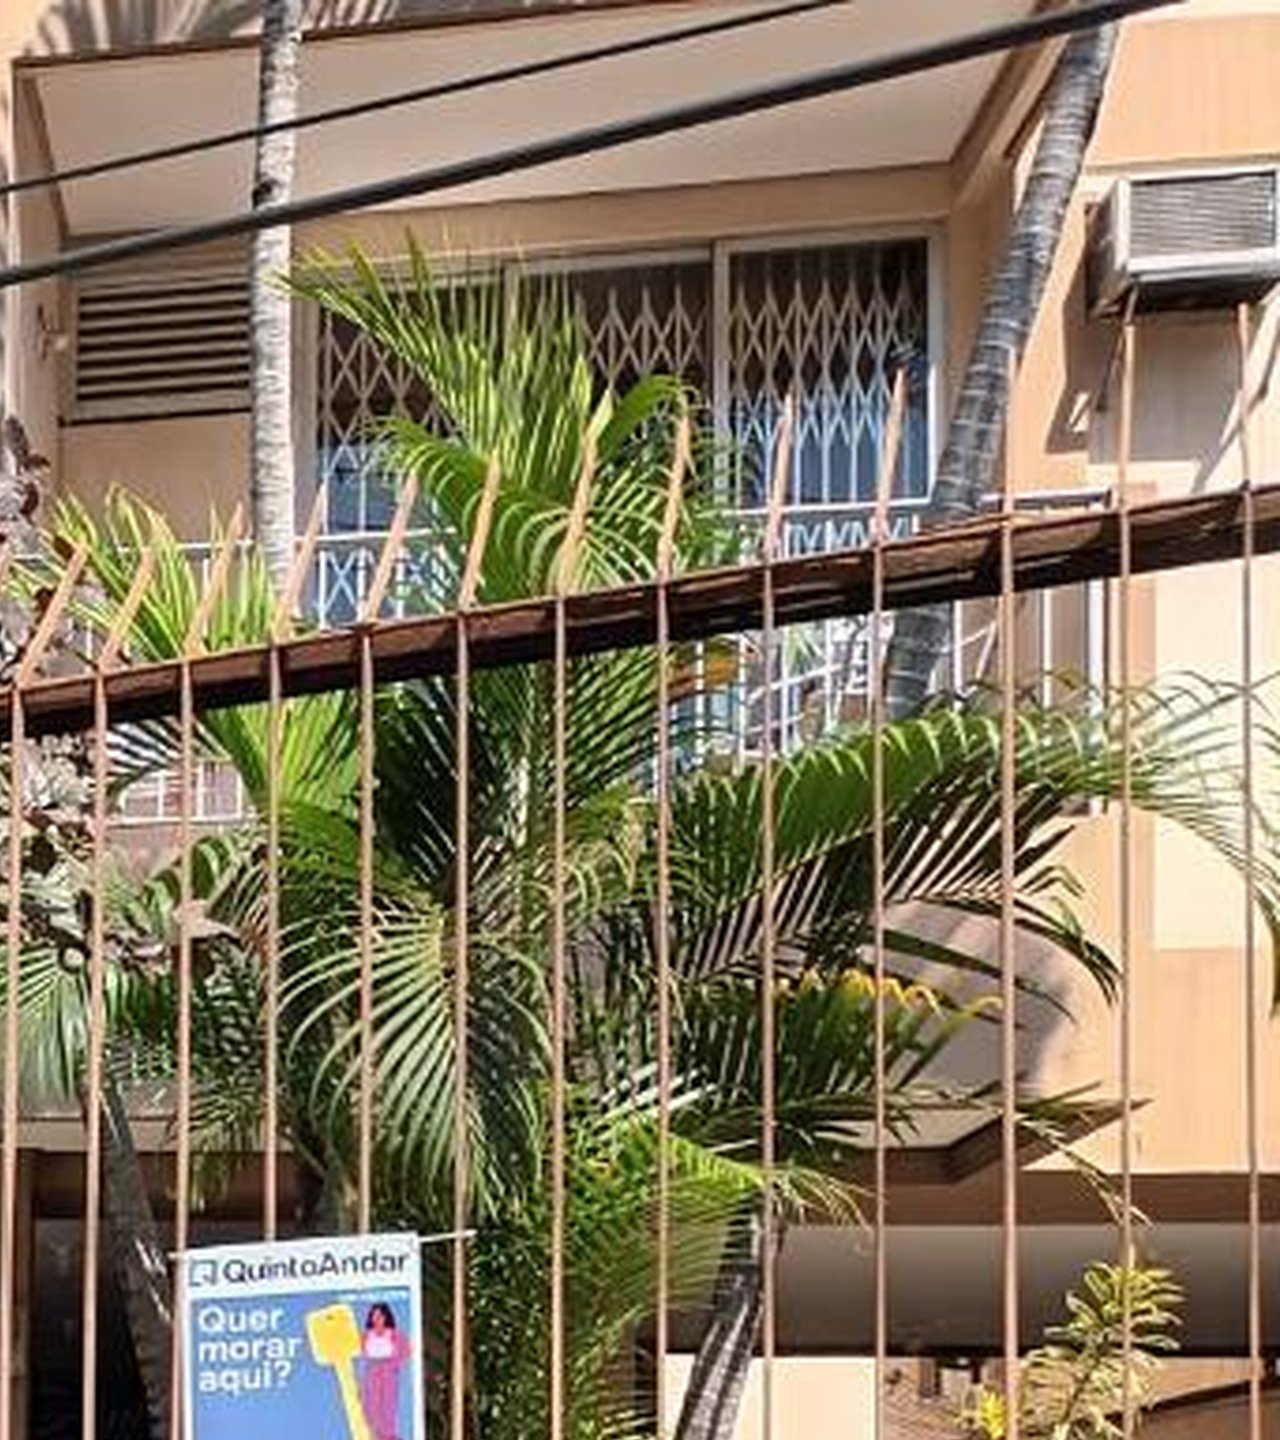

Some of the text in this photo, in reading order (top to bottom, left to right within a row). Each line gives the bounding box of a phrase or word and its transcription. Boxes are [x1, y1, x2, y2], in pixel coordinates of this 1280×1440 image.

[222, 1249, 409, 1284] QuintoAndar
[199, 1306, 285, 1333] Quer
[199, 1338, 302, 1362] morar
[199, 1360, 292, 1397] aqui?
